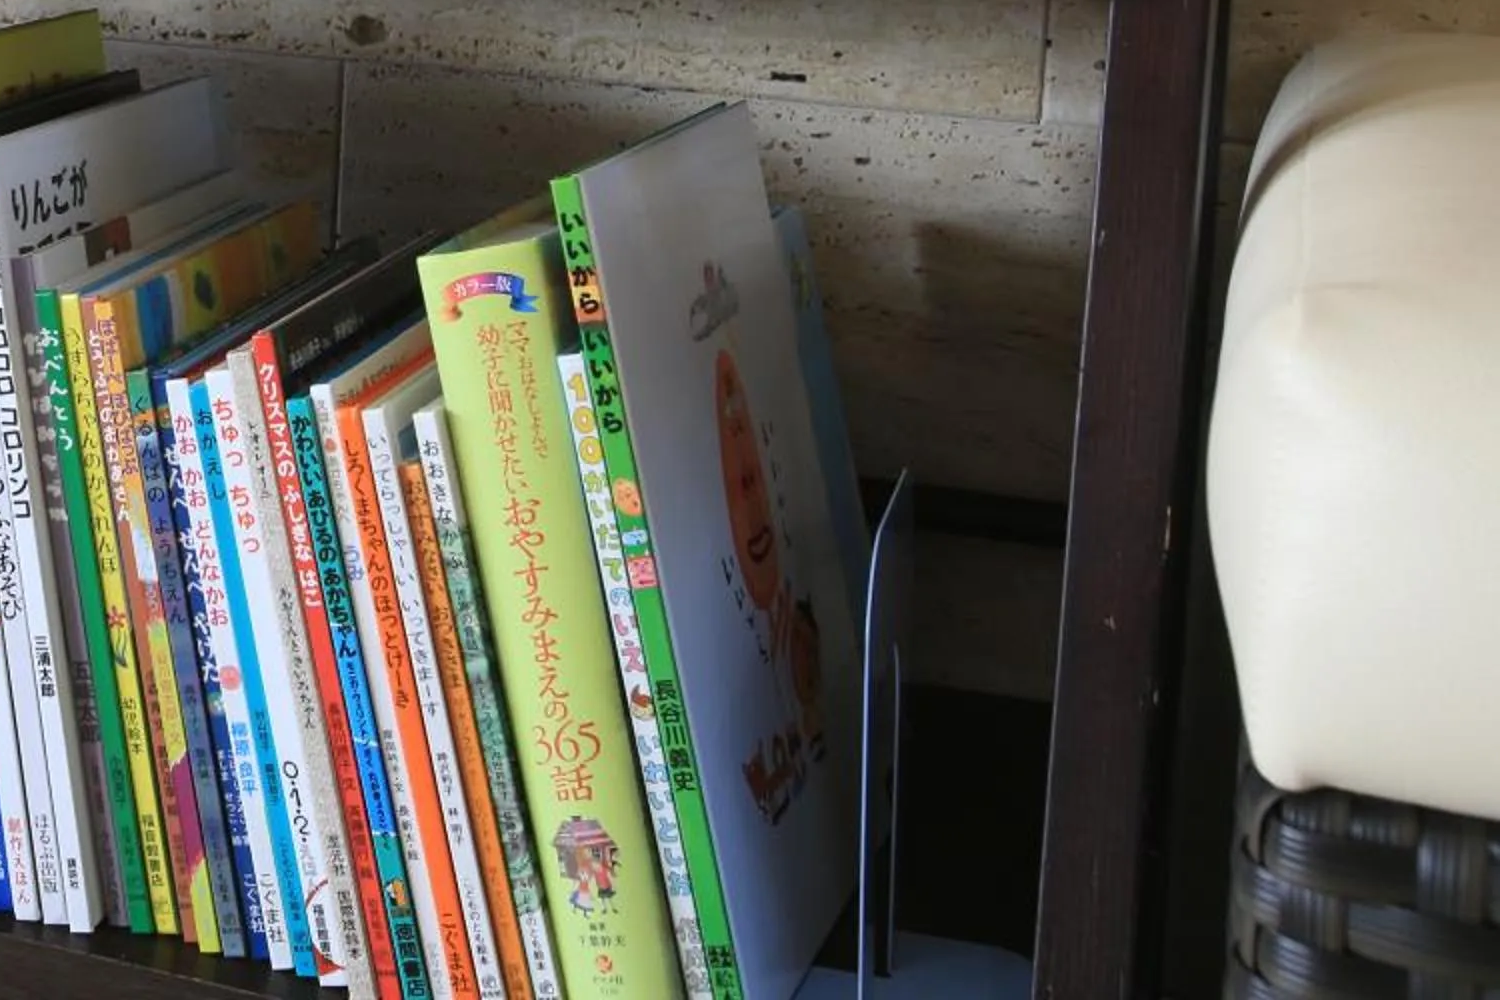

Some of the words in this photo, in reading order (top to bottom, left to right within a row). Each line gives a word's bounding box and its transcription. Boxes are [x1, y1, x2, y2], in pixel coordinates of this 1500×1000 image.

[11, 159, 88, 231] りんごが
[452, 279, 513, 299] カラー版
[559, 211, 599, 314] いいから
[585, 330, 624, 434] いいから
[174, 414, 197, 455] かお
[197, 407, 228, 499] おかえし
[476, 323, 528, 490] 幼子に聞かせたい
[183, 467, 207, 508] かお
[213, 397, 244, 467] ちゅっ
[230, 484, 261, 553] ちゅっ
[259, 364, 297, 479] クリスマスの
[283, 484, 312, 561] ふしぎな
[298, 569, 323, 608] はこ
[422, 440, 469, 570] おおきなかぶ
[567, 372, 646, 674] 100かいだてのいえ
[154, 515, 186, 624] ようちえん
[194, 519, 229, 627] どんなかお
[291, 413, 325, 487] かわいい
[323, 567, 357, 658] あかちゃん
[344, 437, 409, 709] しろくまちゃんのほっとけーき
[370, 435, 415, 585] いってらっしゃーい
[399, 598, 438, 718] いってきまーす
[33, 636, 56, 698] 三浦太郎
[654, 679, 697, 792] 長谷川義史
[259, 872, 285, 943] こぐま社
[438, 913, 473, 992] こぐま社
